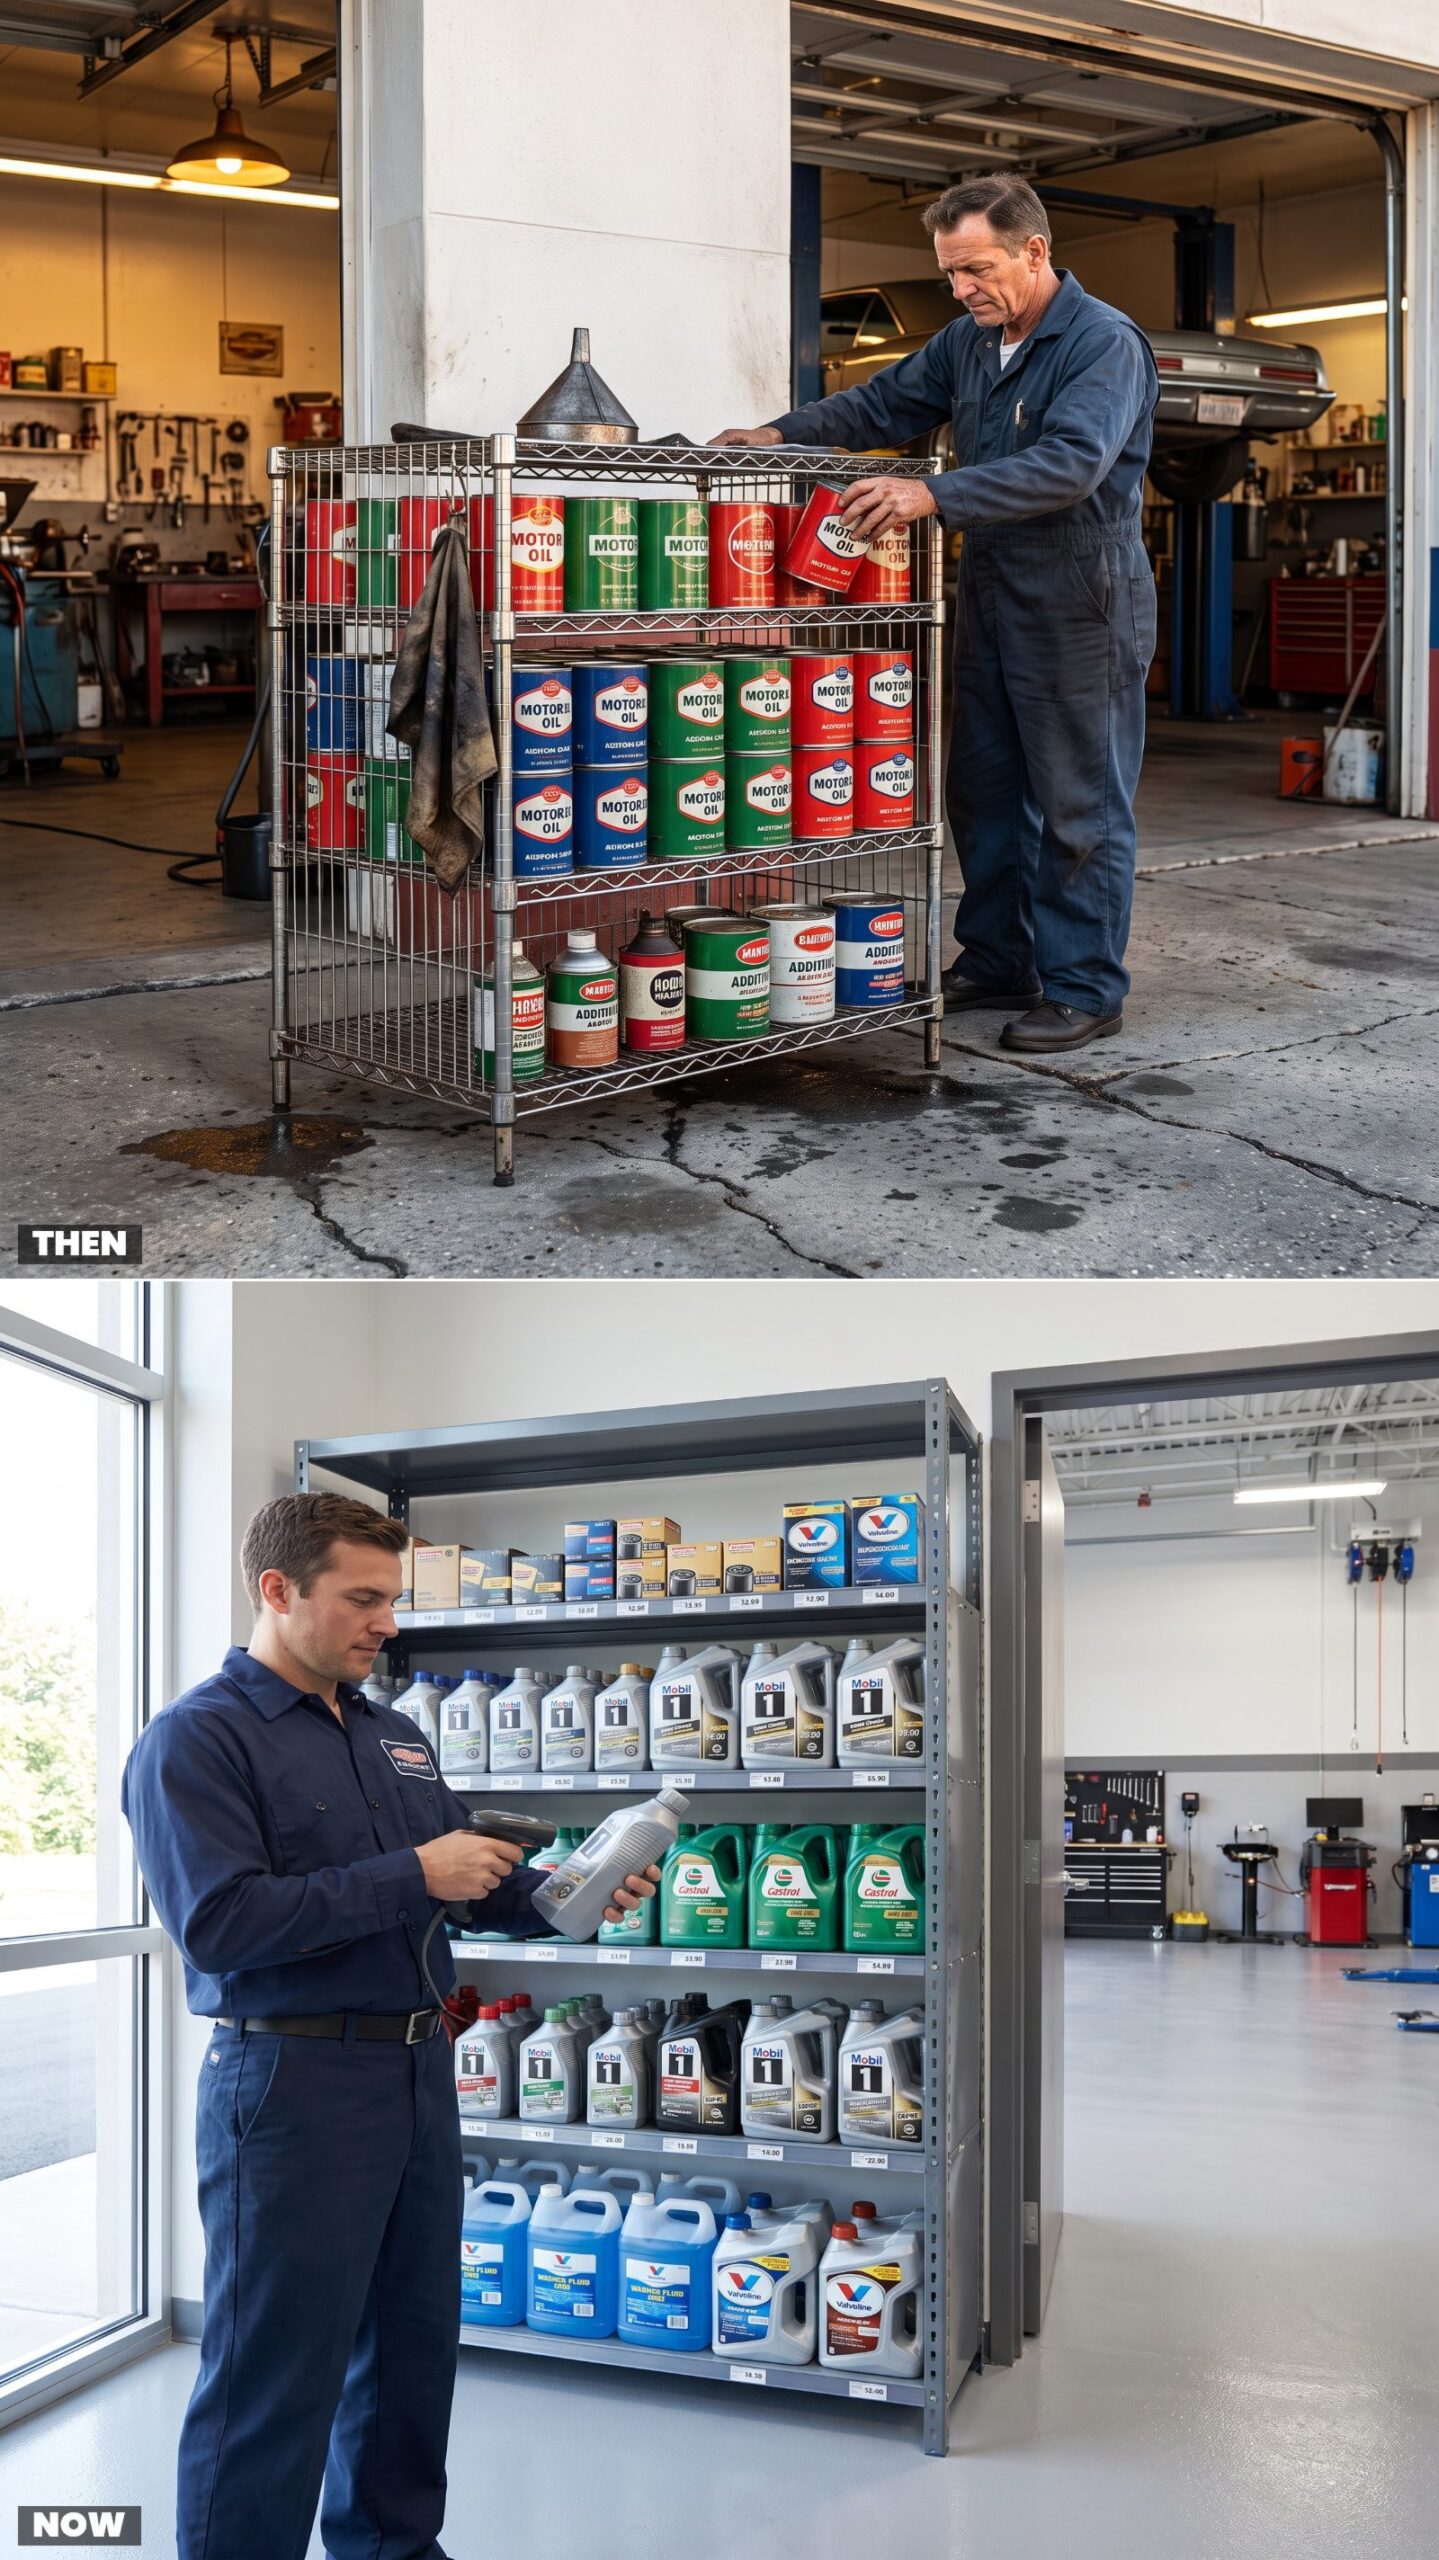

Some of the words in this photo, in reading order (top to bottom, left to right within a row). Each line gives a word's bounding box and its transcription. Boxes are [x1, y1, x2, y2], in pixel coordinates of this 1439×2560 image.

[512, 533, 562, 547] MOTOR
[836, 539, 855, 554] OIL
[529, 549, 552, 562] OIL
[889, 553, 907, 564] OIL
[835, 697, 848, 708] OIL
[892, 692, 906, 703] OIL
[702, 706, 718, 718] OIL
[764, 701, 782, 713] OIL
[621, 711, 638, 723] OIL
[542, 717, 561, 729] OIL
[892, 781, 907, 793] OIL
[832, 789, 847, 800] OIL
[771, 796, 786, 808] OIL
[704, 804, 719, 816] OIL
[623, 813, 639, 825] OIL
[542, 823, 561, 834] OIL
[867, 1529, 898, 1537] Valvoline
[798, 1540, 827, 1548] Valvoline
[755, 1681, 785, 1692] Mobil
[852, 1678, 883, 1688] Mobil
[662, 1684, 691, 1694] Mobil
[605, 1697, 627, 1707] Mobil
[678, 1886, 710, 1895] Castrol
[767, 1887, 800, 1897] Castrol
[864, 1888, 898, 1898] Castrol
[462, 2044, 484, 2053] Mobil
[669, 2044, 694, 2054] Mobil
[753, 2047, 783, 2058] Mobil
[851, 2054, 882, 2065] Mobil
[727, 2290, 761, 2301] Valvoline
[836, 2300, 872, 2312] Valvoline
